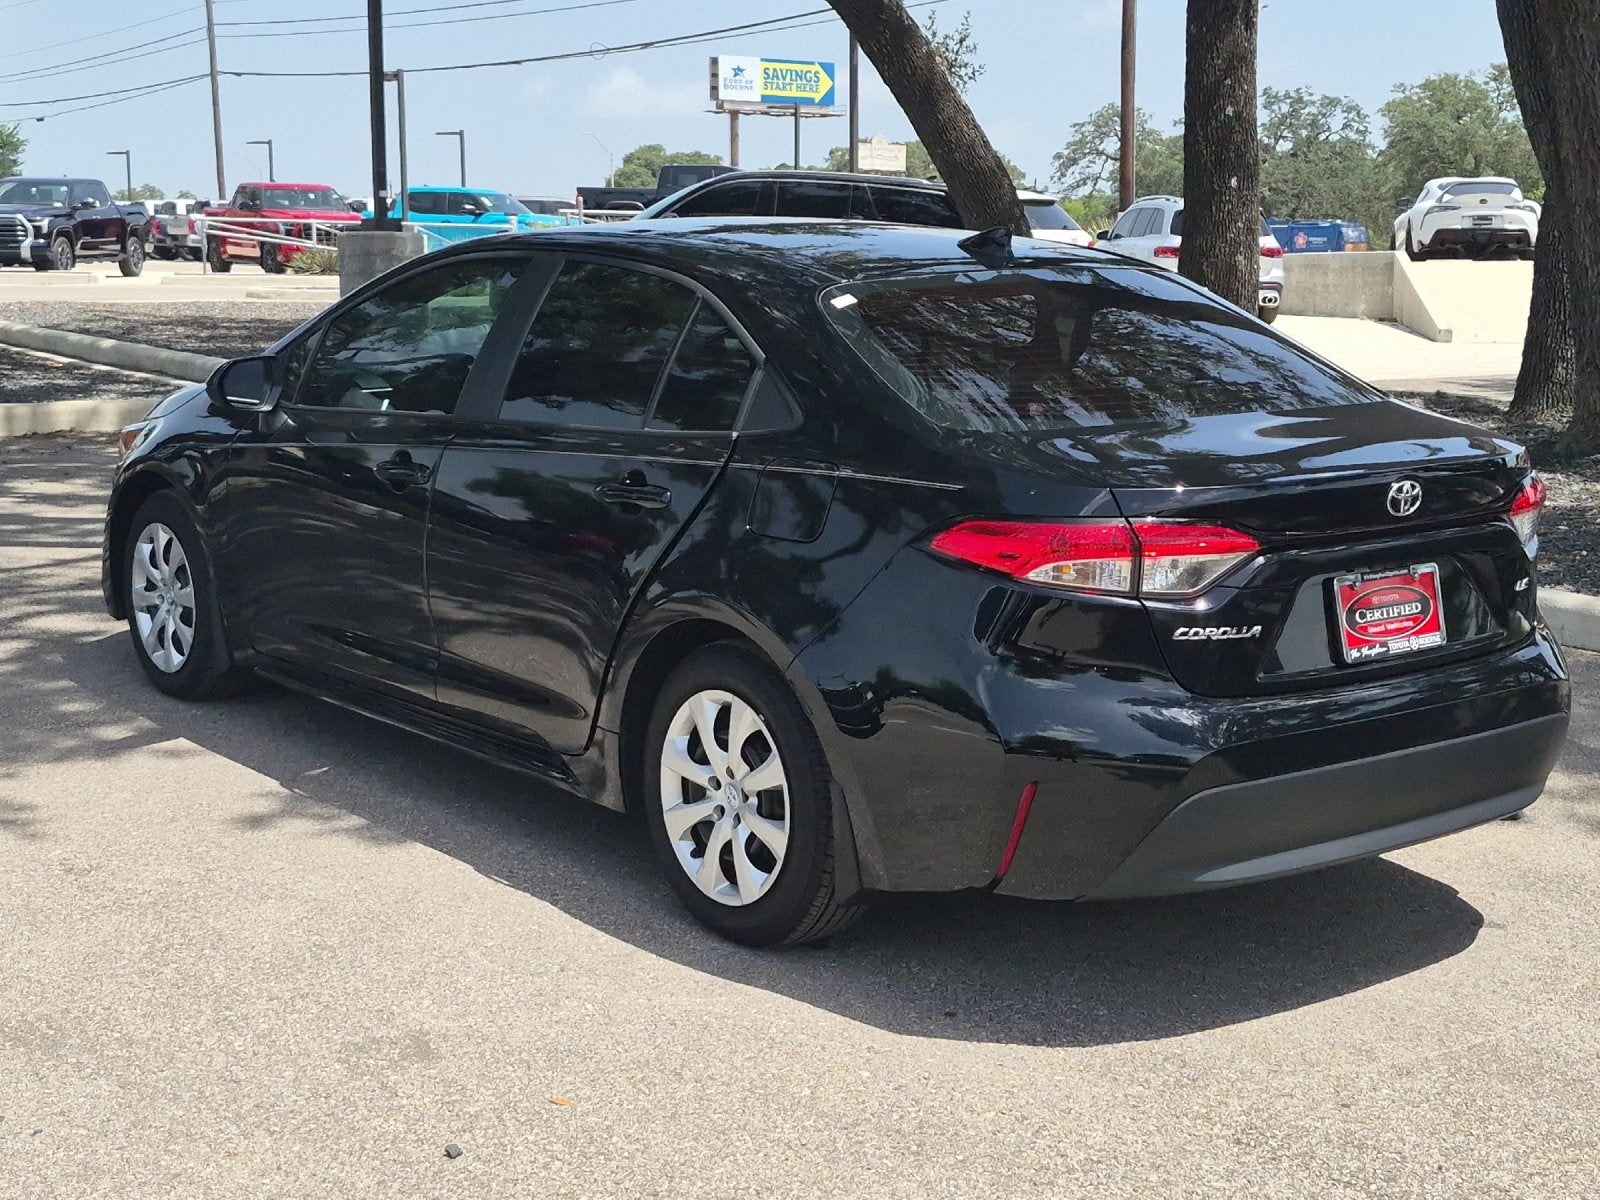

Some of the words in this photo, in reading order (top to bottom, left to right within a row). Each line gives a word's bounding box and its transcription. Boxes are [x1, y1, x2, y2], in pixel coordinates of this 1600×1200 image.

[763, 67, 820, 83] SAVINGS
[763, 81, 793, 92] START
[796, 83, 820, 93] HERE
[1514, 577, 1529, 591] LE
[1379, 593, 1400, 602] TOYOTA
[1355, 602, 1422, 623] CERTIFIED
[1172, 625, 1262, 640] COROLLA
[1367, 623, 1385, 634] Used
[1386, 620, 1414, 631] Vehicles
[1388, 641, 1410, 651] TOYOTA
